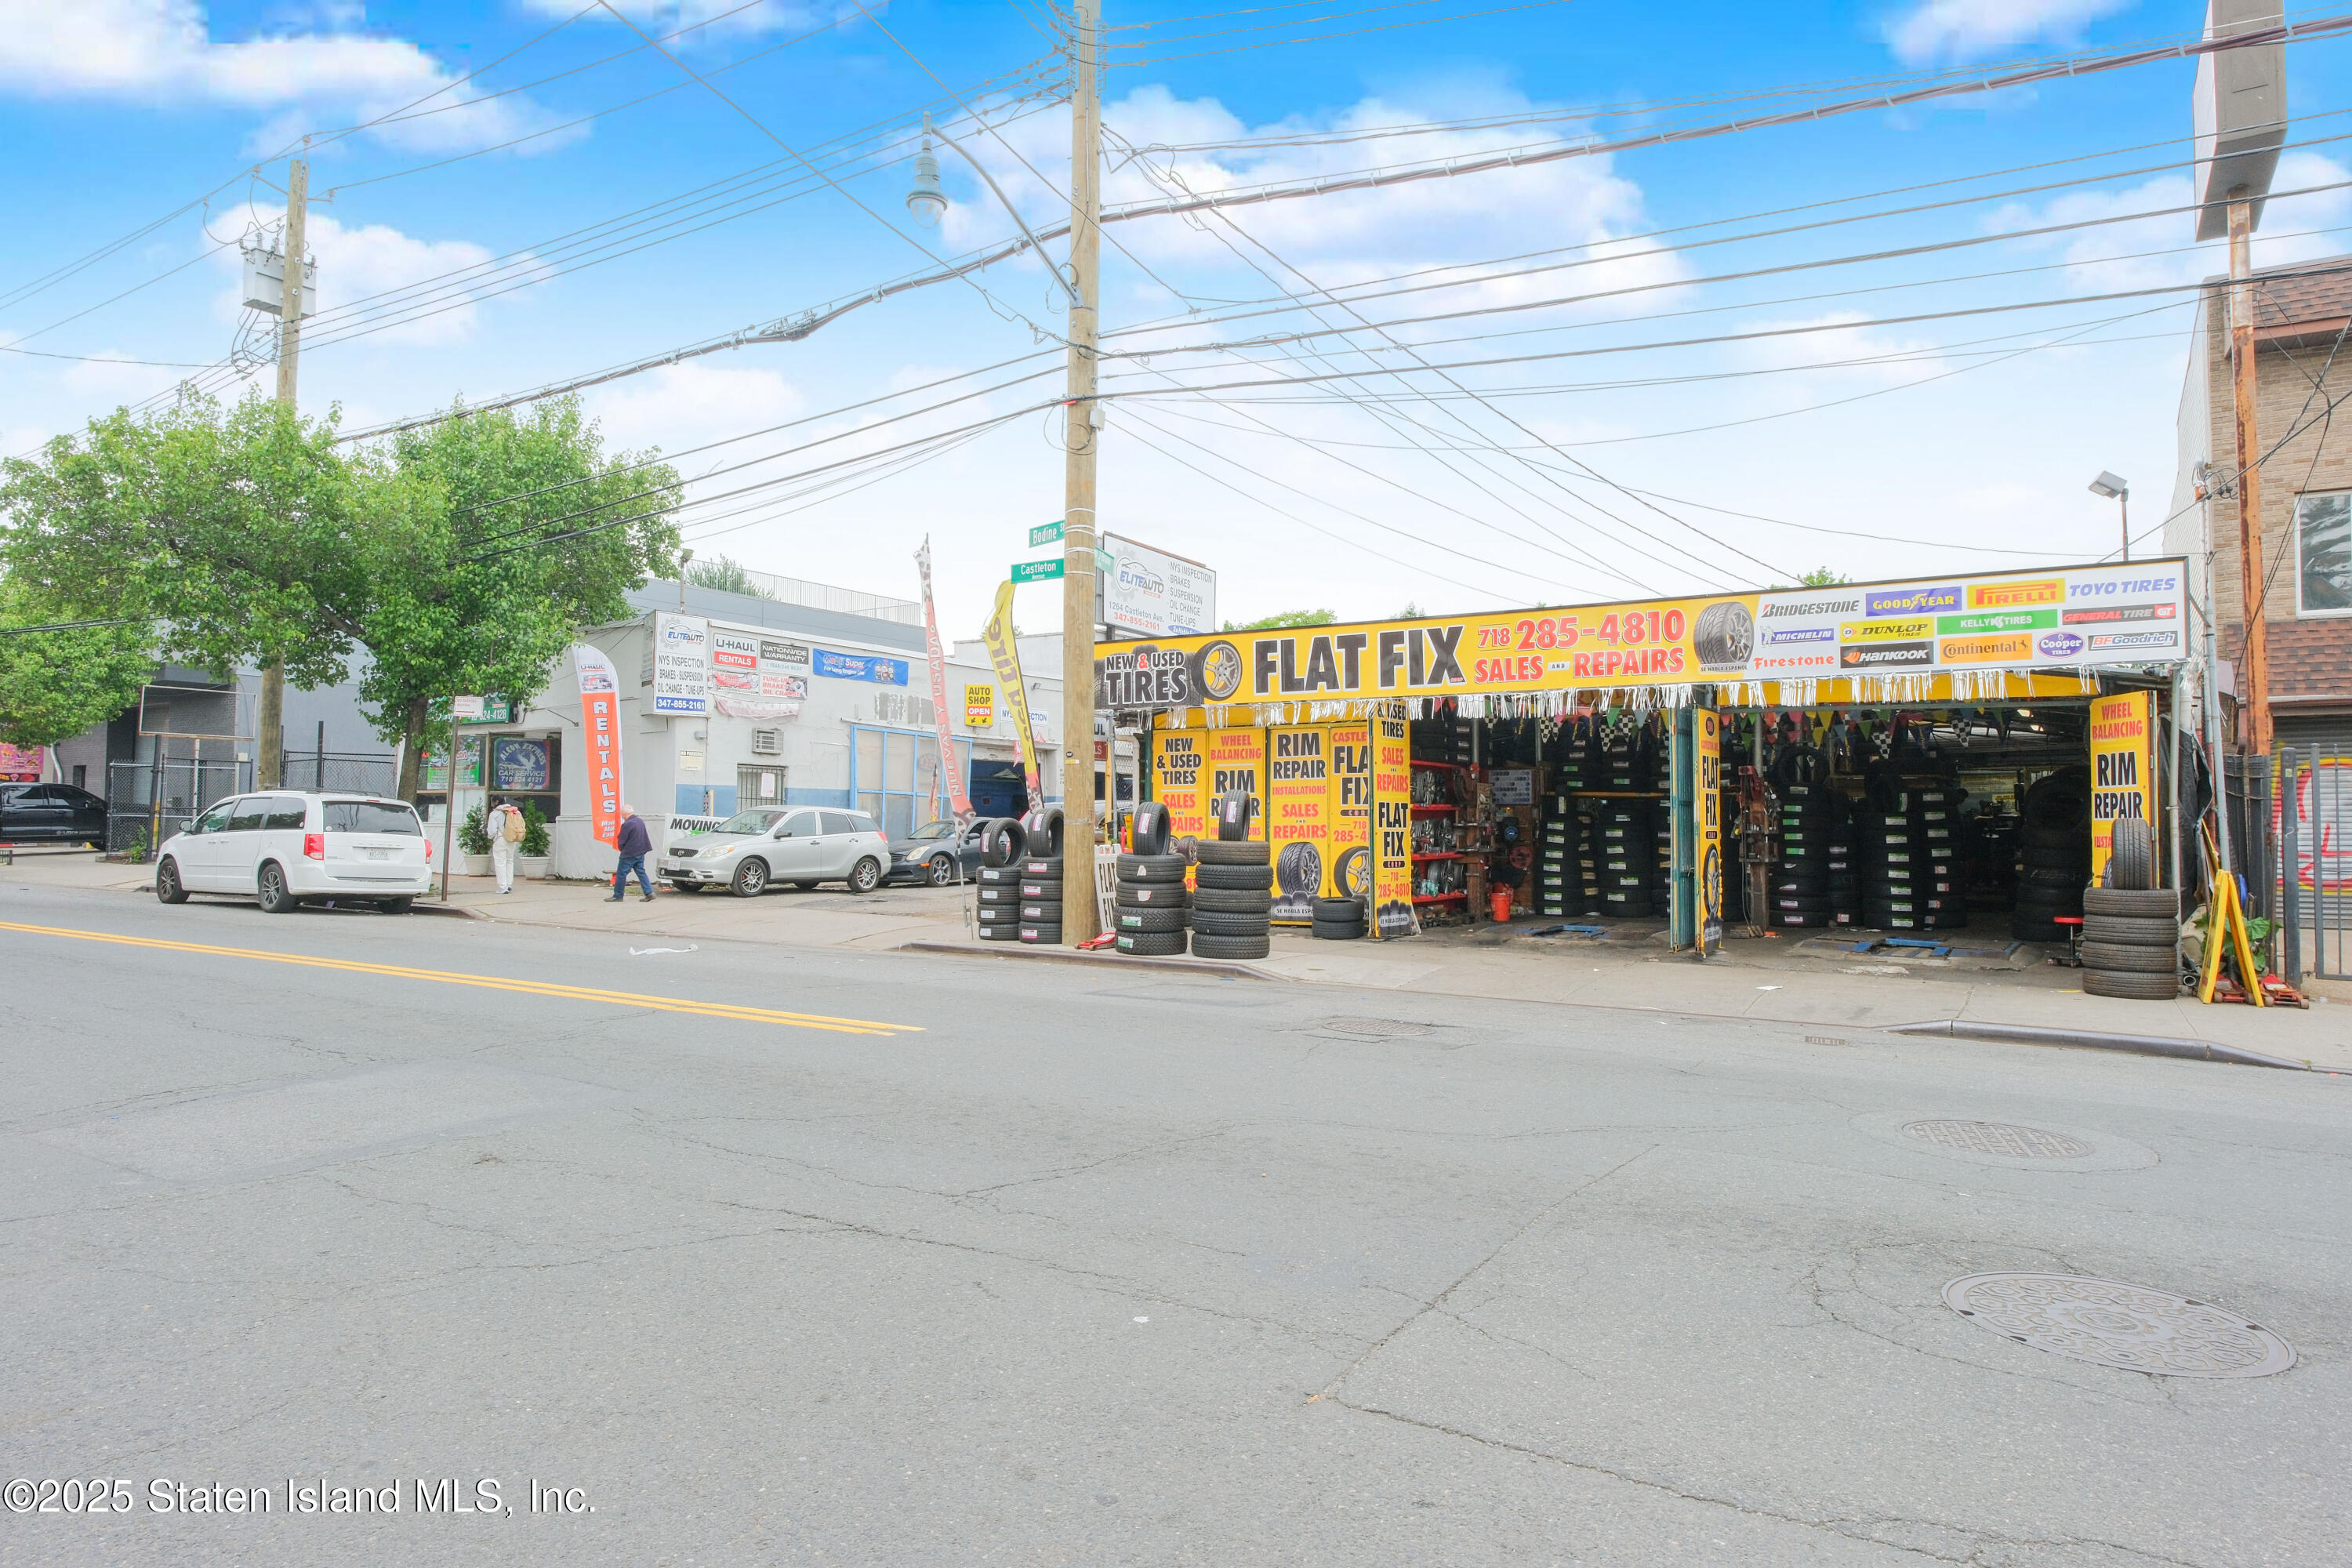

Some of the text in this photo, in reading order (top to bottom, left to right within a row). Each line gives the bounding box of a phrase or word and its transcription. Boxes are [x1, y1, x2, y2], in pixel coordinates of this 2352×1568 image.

[1033, 527, 1057, 544] Bodine
[1021, 562, 1056, 575] Castleton
[1170, 562, 1212, 583] NYS INSPECTION
[1170, 574, 1191, 589] BRAKES
[2070, 577, 2176, 597] TOYO TIRES
[1170, 587, 1203, 605] SUSPENSION
[1873, 593, 1955, 611] GOODYEAR
[1975, 583, 2057, 605] PIRELLI
[1109, 601, 1164, 622] 1264 Castleton Ave.
[1170, 600, 1200, 616] OIL CHANGE
[1761, 600, 1860, 619] BRIDGESTONE
[2063, 610, 2123, 622] GENERAL
[2123, 608, 2153, 619] TIRE
[1114, 612, 1160, 631] 347-855-2161
[1170, 612, 1196, 627] TUNE-UPS
[1960, 615, 2033, 628] KELLY TIRES
[1478, 608, 1686, 652] 718 285-4810
[1775, 630, 1832, 641] MICHELIN
[1861, 623, 1929, 635] DUNLOP
[716, 638, 755, 652] U-HAUL
[2040, 638, 2083, 650] Cooper
[2093, 633, 2175, 646] BFGoodrich
[762, 645, 807, 655] NATIONWIDE
[764, 652, 806, 662] WARRANTY
[1944, 640, 2016, 658] Continental
[659, 655, 704, 669] NYS INSPECTION
[718, 654, 752, 666] RENTALS
[845, 659, 865, 668] Super
[1105, 651, 1185, 671] NEW & USED
[1254, 625, 1467, 696] FLAT FIX
[1475, 655, 1544, 684] SALES
[1573, 647, 1685, 678] REPAIRS
[1753, 655, 1835, 670] Firestone
[659, 670, 676, 679] BRAKES
[679, 670, 703, 682] SUSPENSION
[666, 686, 683, 695] CHANGE
[685, 688, 704, 696] TUNE-UPS
[1105, 667, 1188, 705] TIRES
[657, 699, 705, 710] 347-855-2161
[968, 696, 991, 705] SHOP
[937, 706, 945, 715] Y
[1387, 703, 1406, 720] USED
[2102, 702, 2132, 719] WHEEL
[1333, 731, 1367, 742] CASTLE
[1381, 720, 1404, 739] TIRES
[2092, 720, 2143, 740] BALANCING
[1165, 738, 1193, 753] NEW
[1221, 735, 1251, 746] WHEEL
[1277, 732, 1320, 757] RIM
[522, 743, 546, 765] EXPRESS
[592, 701, 616, 814] RENTALS
[939, 725, 962, 797] NUEVAS
[1156, 754, 1202, 769] & USED
[1210, 748, 1262, 760] BALANCING
[1334, 745, 1369, 775] FLA
[1381, 746, 1404, 765] SALES
[1273, 760, 1326, 780] REPAIR
[1702, 755, 1719, 790] FLAT
[2097, 751, 2137, 787] RIM
[1162, 770, 1196, 785] TIRES
[1215, 770, 1255, 794] RIM
[1377, 774, 1409, 793] REPAIRS
[1272, 786, 1326, 795] INSTALLATIONS
[1163, 793, 1196, 809] SALES
[2094, 792, 2143, 820] REPAIR
[1282, 804, 1319, 818] SALES
[1378, 802, 1408, 829] FLAT
[1704, 793, 1718, 827] FIX
[1171, 817, 1203, 832] PAIRS
[1273, 825, 1327, 839] REPAIRS
[1334, 830, 1367, 842] 285-4
[1383, 831, 1405, 858] FIX
[1390, 872, 1399, 881] 718
[1378, 883, 1410, 898] 285-4810
